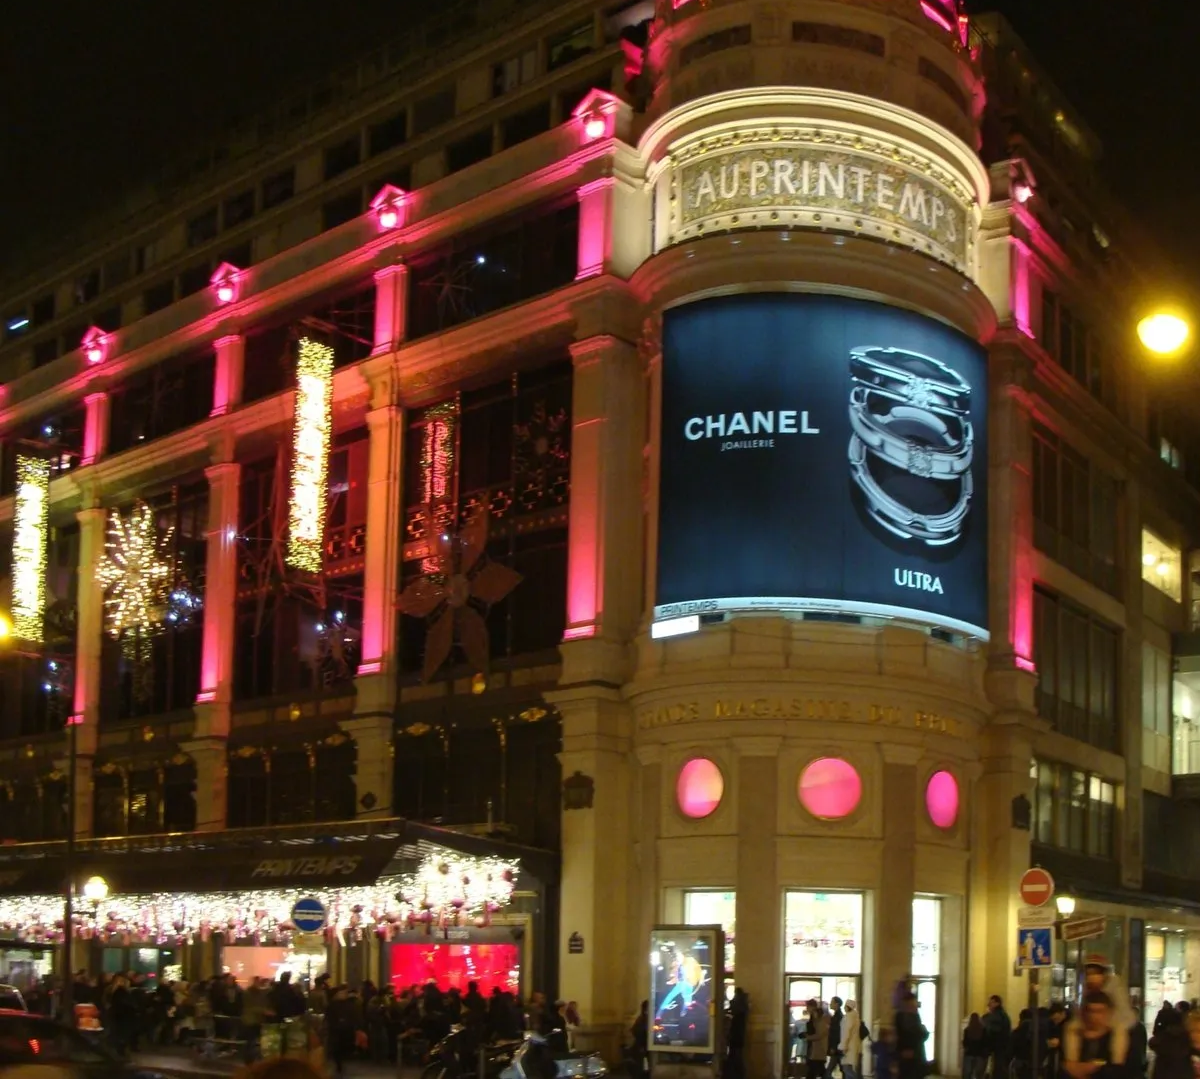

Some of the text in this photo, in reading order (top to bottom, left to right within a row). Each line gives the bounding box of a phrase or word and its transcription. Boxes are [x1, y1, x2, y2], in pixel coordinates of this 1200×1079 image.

[695, 159, 957, 243] AU PRINTEMPS
[684, 410, 820, 441] CHANEL
[720, 438, 776, 452] JOAILLERIE
[894, 567, 944, 595] ULTRA
[660, 600, 719, 616] PRINTEMPS
